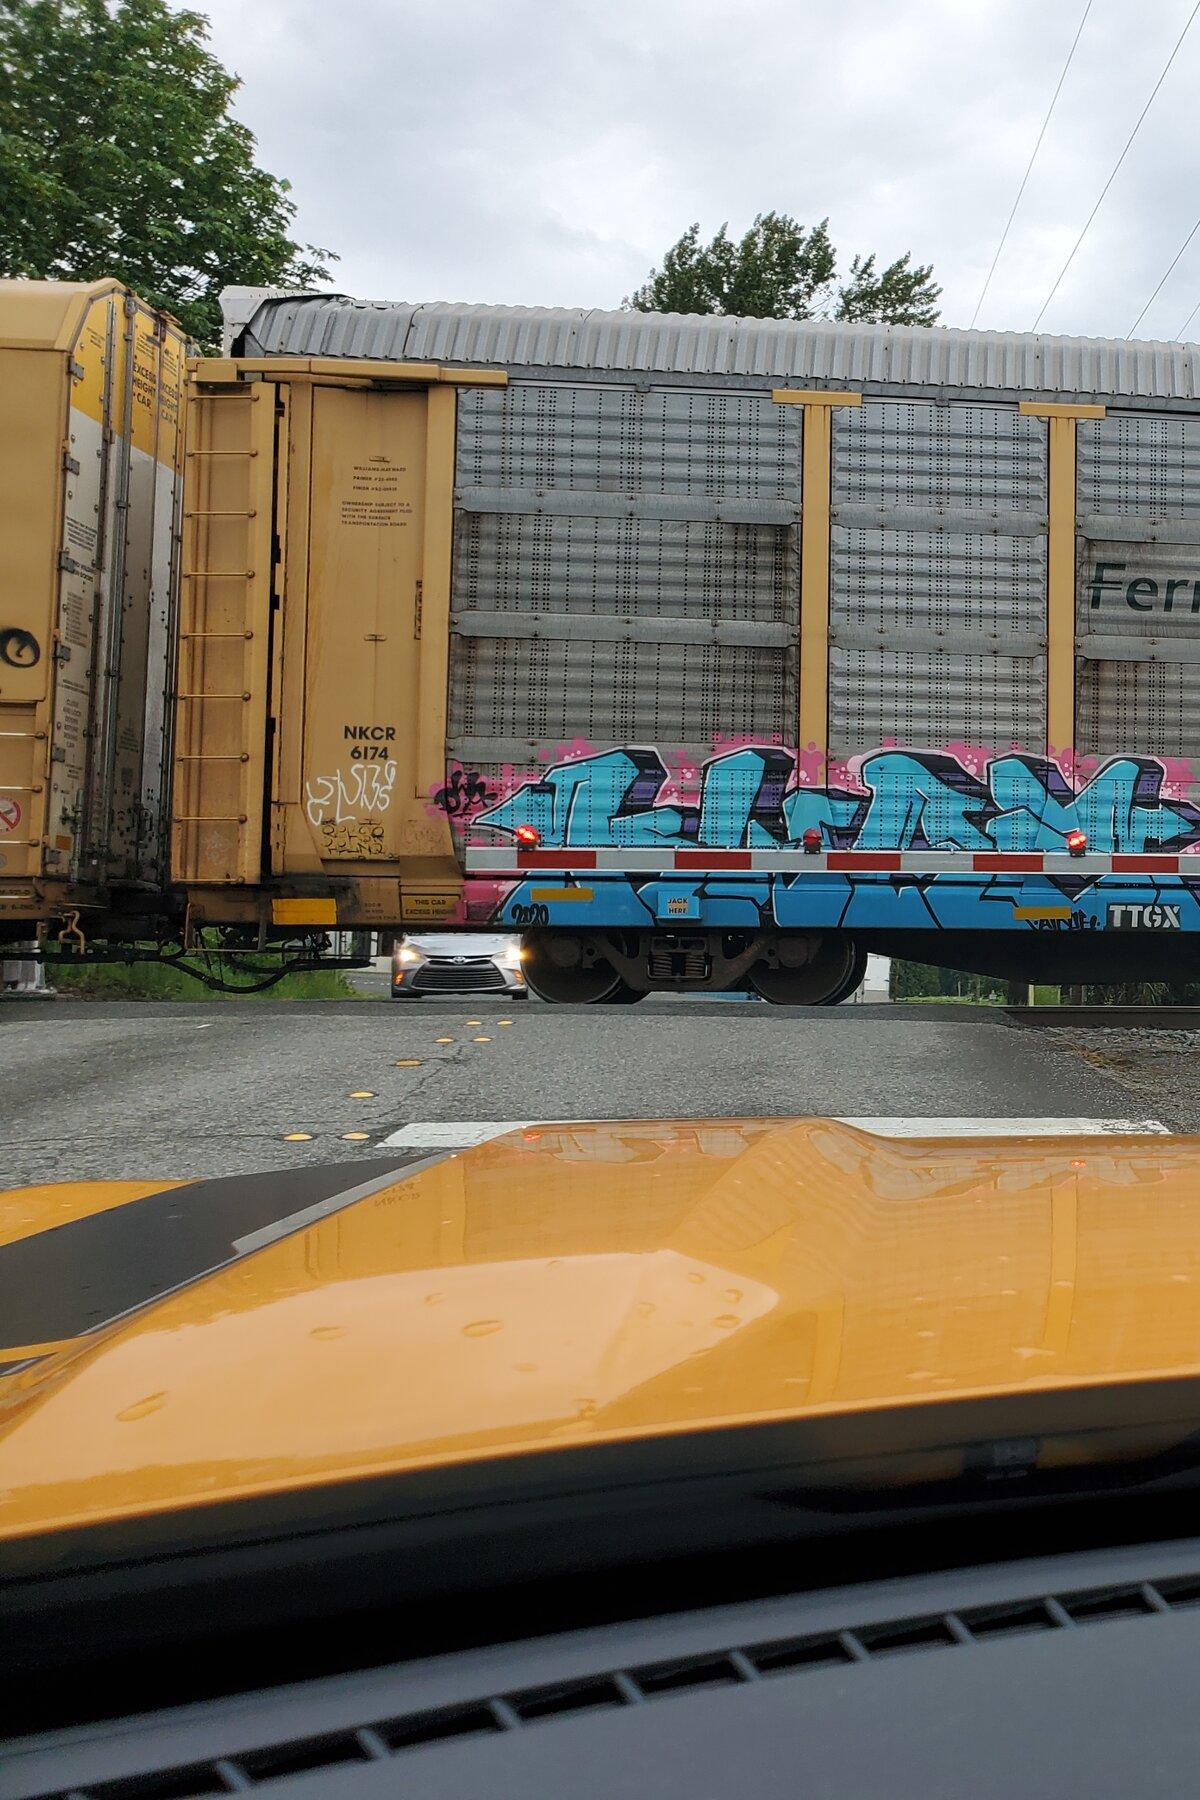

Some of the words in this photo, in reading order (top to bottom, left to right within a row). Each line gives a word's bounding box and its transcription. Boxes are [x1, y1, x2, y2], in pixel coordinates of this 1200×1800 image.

[137, 392, 152, 409] CAR
[344, 725, 396, 741] NKCR
[350, 746, 389, 761] 6174
[511, 903, 550, 927] 2020
[1109, 905, 1181, 929] TTGX
